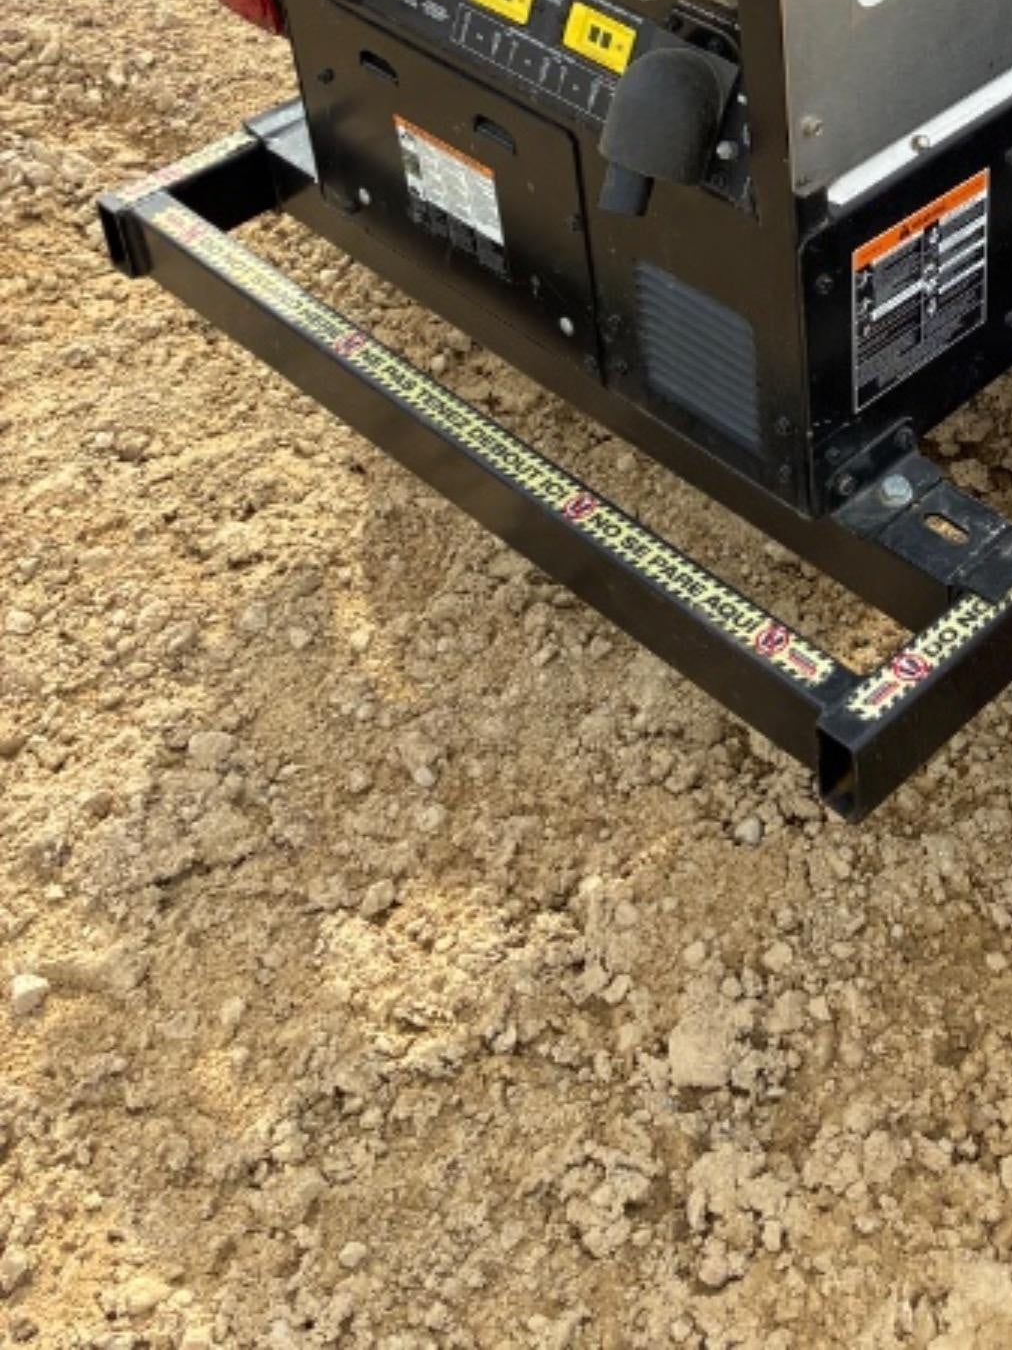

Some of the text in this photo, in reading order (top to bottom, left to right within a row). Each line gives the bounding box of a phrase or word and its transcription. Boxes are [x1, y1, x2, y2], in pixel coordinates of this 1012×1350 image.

[379, 364, 419, 391] PAS
[540, 478, 570, 499] ICI
[587, 512, 760, 630] NO SE PARE AQUI
[924, 626, 959, 657] DO
